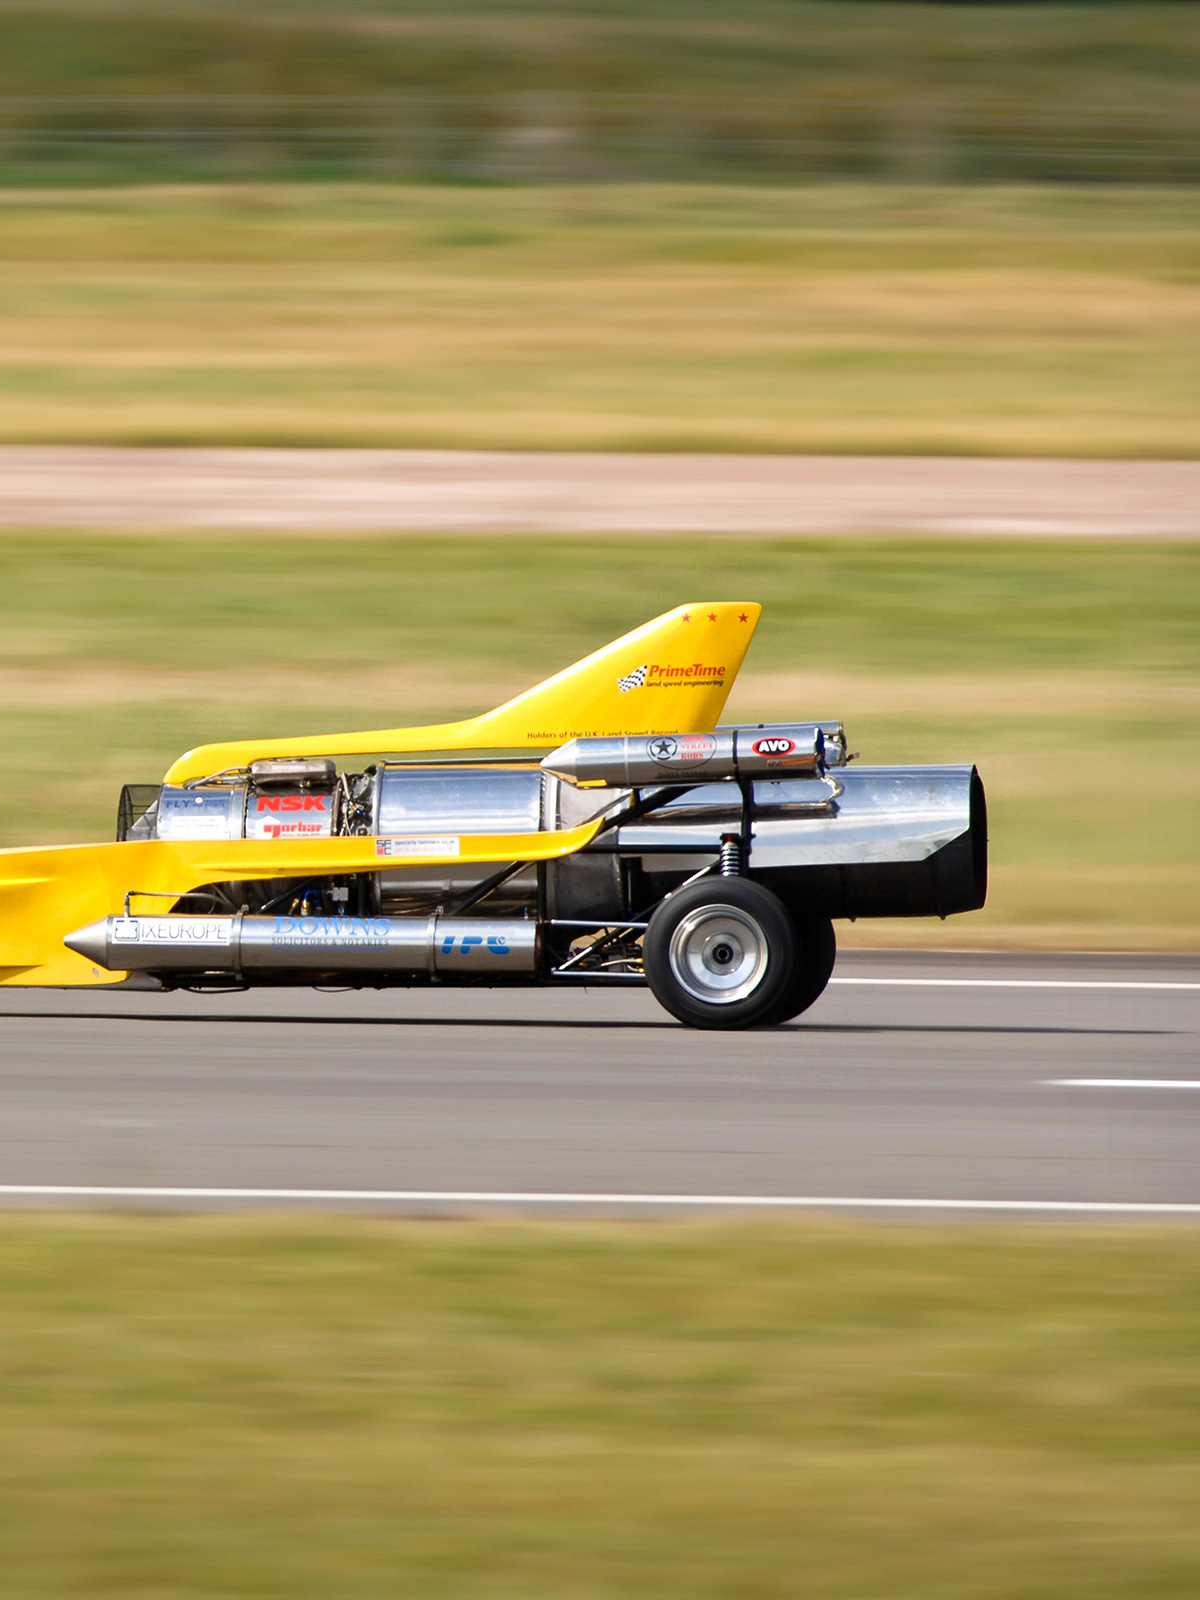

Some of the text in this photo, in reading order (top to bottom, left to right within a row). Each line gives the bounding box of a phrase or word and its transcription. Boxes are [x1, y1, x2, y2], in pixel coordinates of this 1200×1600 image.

[649, 664, 726, 678] PrimeTime
[663, 680, 682, 688] speed
[683, 679, 724, 687] engineering
[527, 731, 557, 739] Holders
[681, 742, 713, 750] STREET
[758, 739, 791, 752] AVO
[681, 752, 704, 760] RODS
[166, 800, 190, 808] FLY
[256, 795, 327, 812] NSK
[273, 916, 392, 936] DOWNS
[141, 923, 227, 940] IXEUROPE
[272, 937, 328, 946] SOLICITORS
[341, 938, 390, 947] NOTARIES
